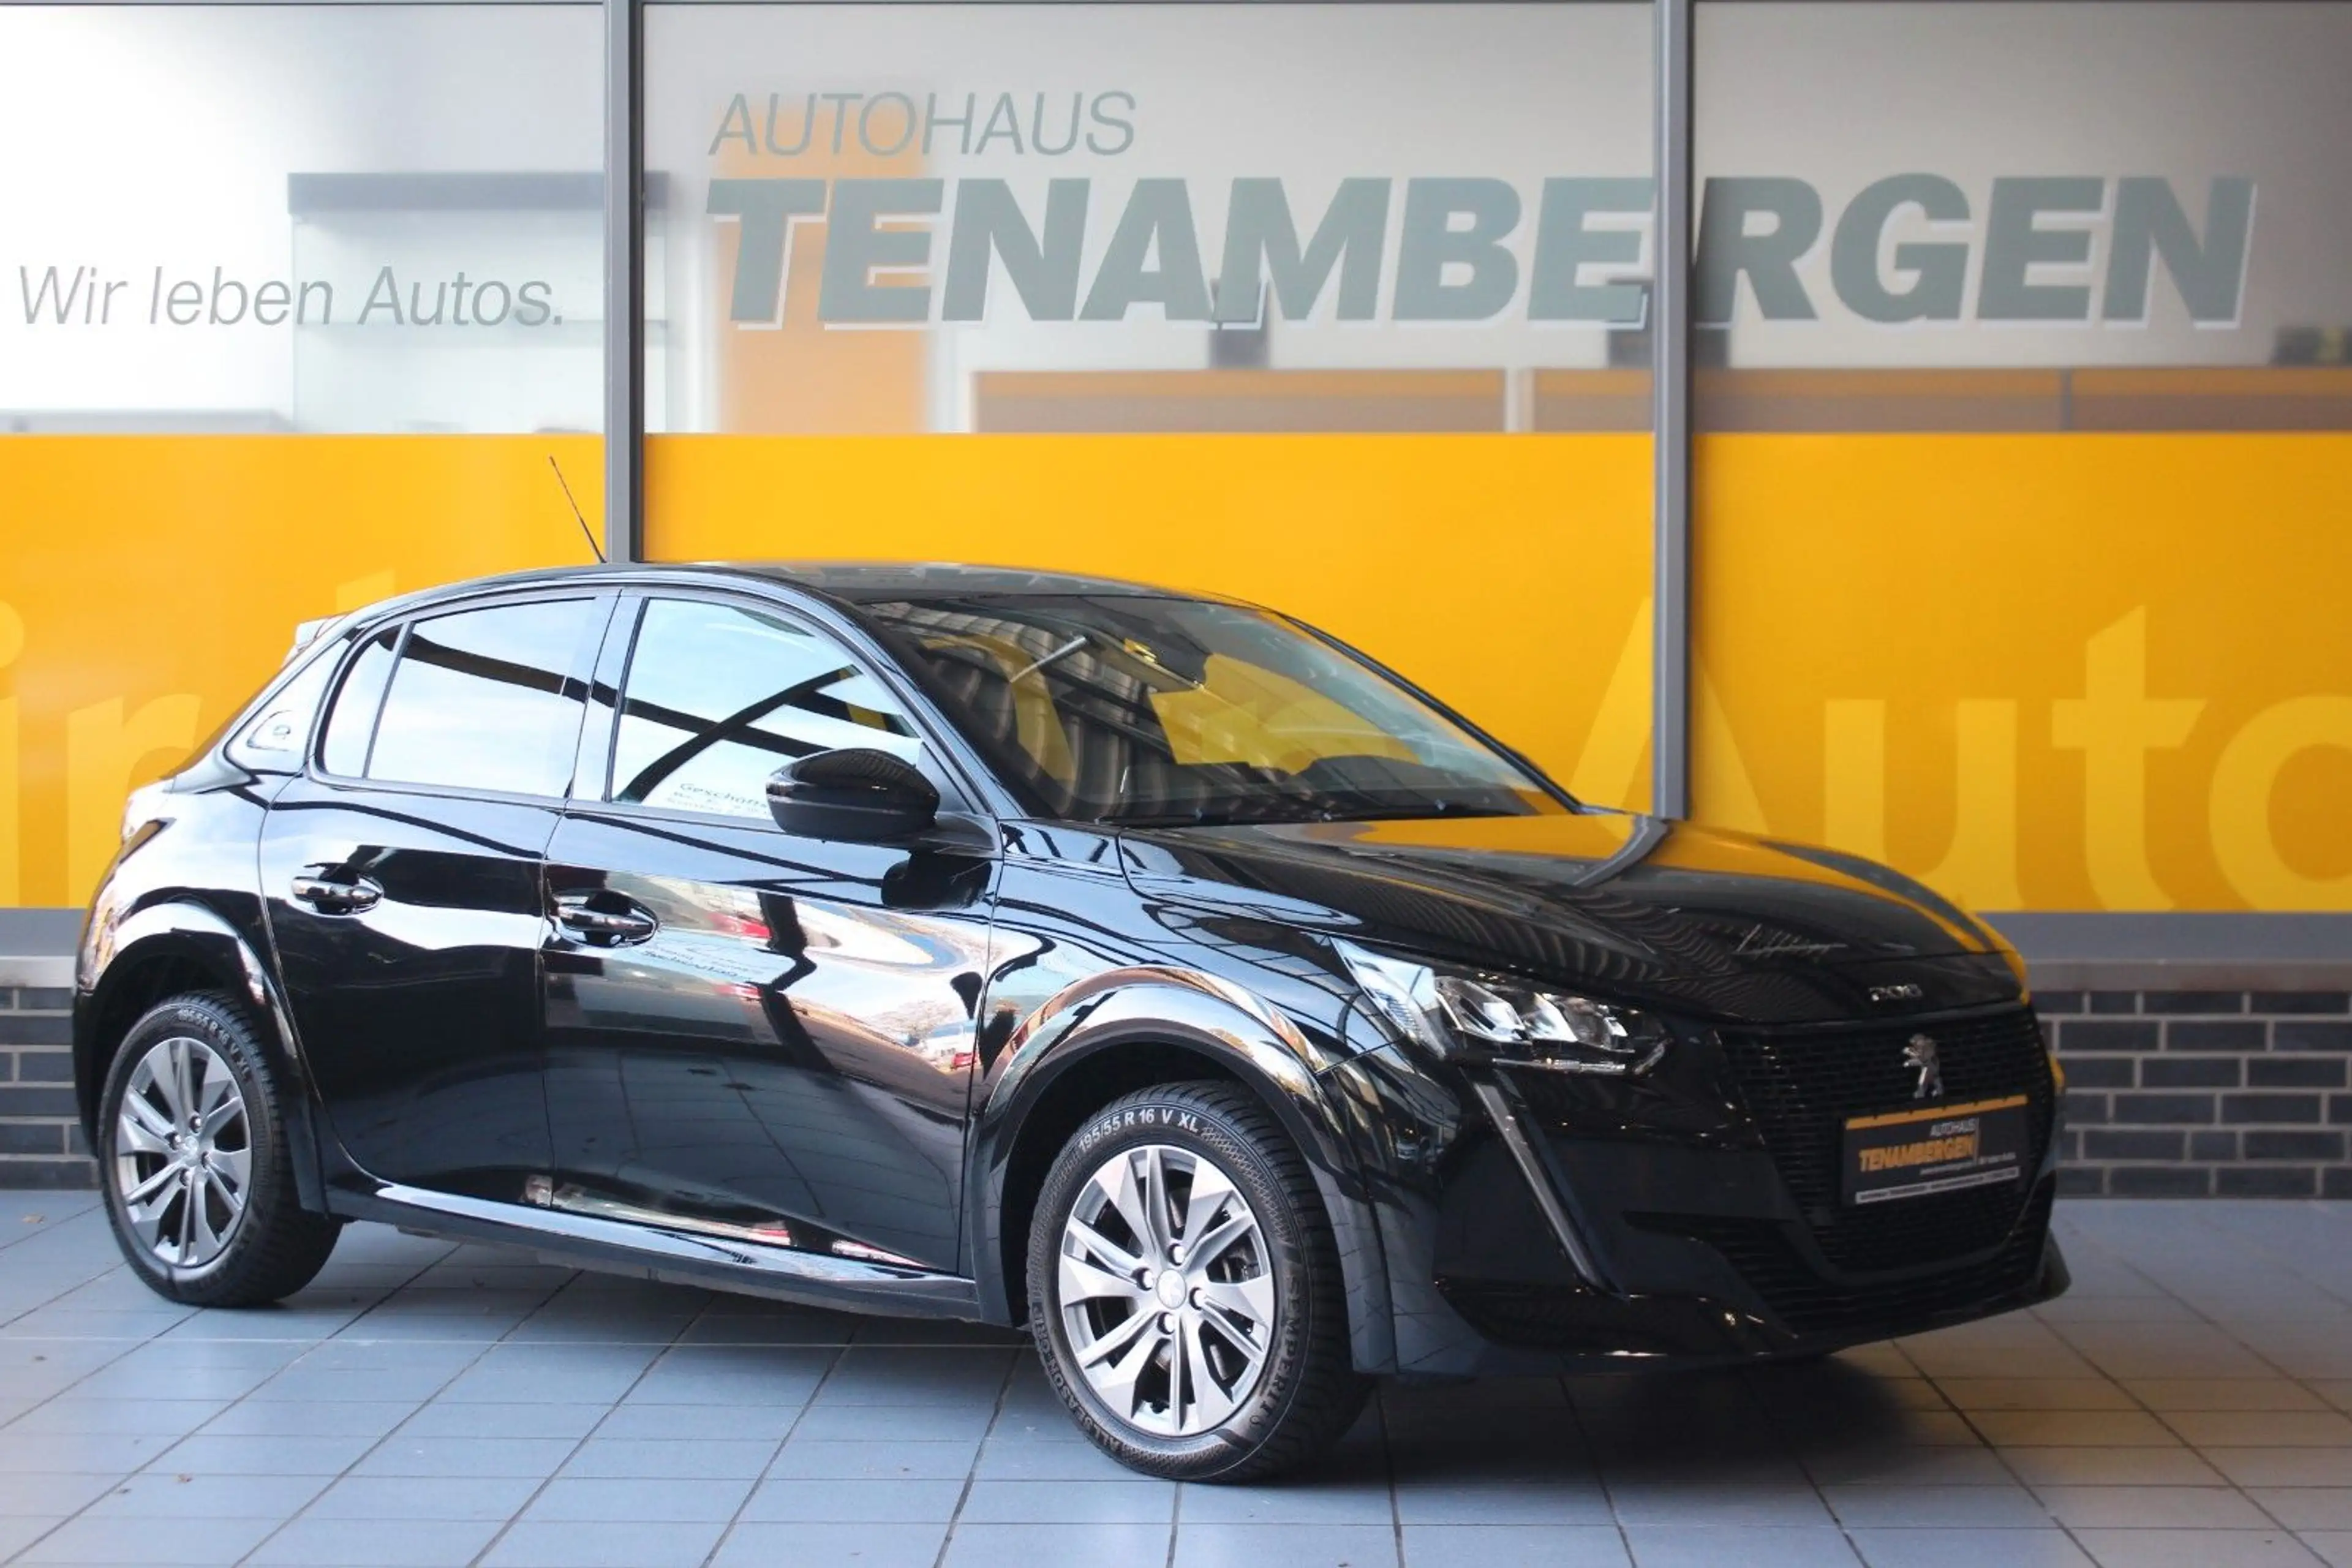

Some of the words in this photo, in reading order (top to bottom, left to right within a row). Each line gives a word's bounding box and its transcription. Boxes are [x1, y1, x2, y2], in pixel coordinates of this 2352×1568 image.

[708, 90, 1137, 156] AUTOHAUS
[706, 173, 2256, 330] TENAMBERGEN
[18, 265, 129, 325] Wir
[149, 265, 334, 326] leben
[357, 265, 564, 326] Autos.
[1078, 1115, 1121, 1153] 195/55
[1124, 1112, 1135, 1126] R
[1139, 1108, 1155, 1124] 16
[1161, 1109, 1174, 1124] V
[1177, 1112, 1199, 1133] XL
[1858, 1133, 1976, 1172] TENAMBERGEN
